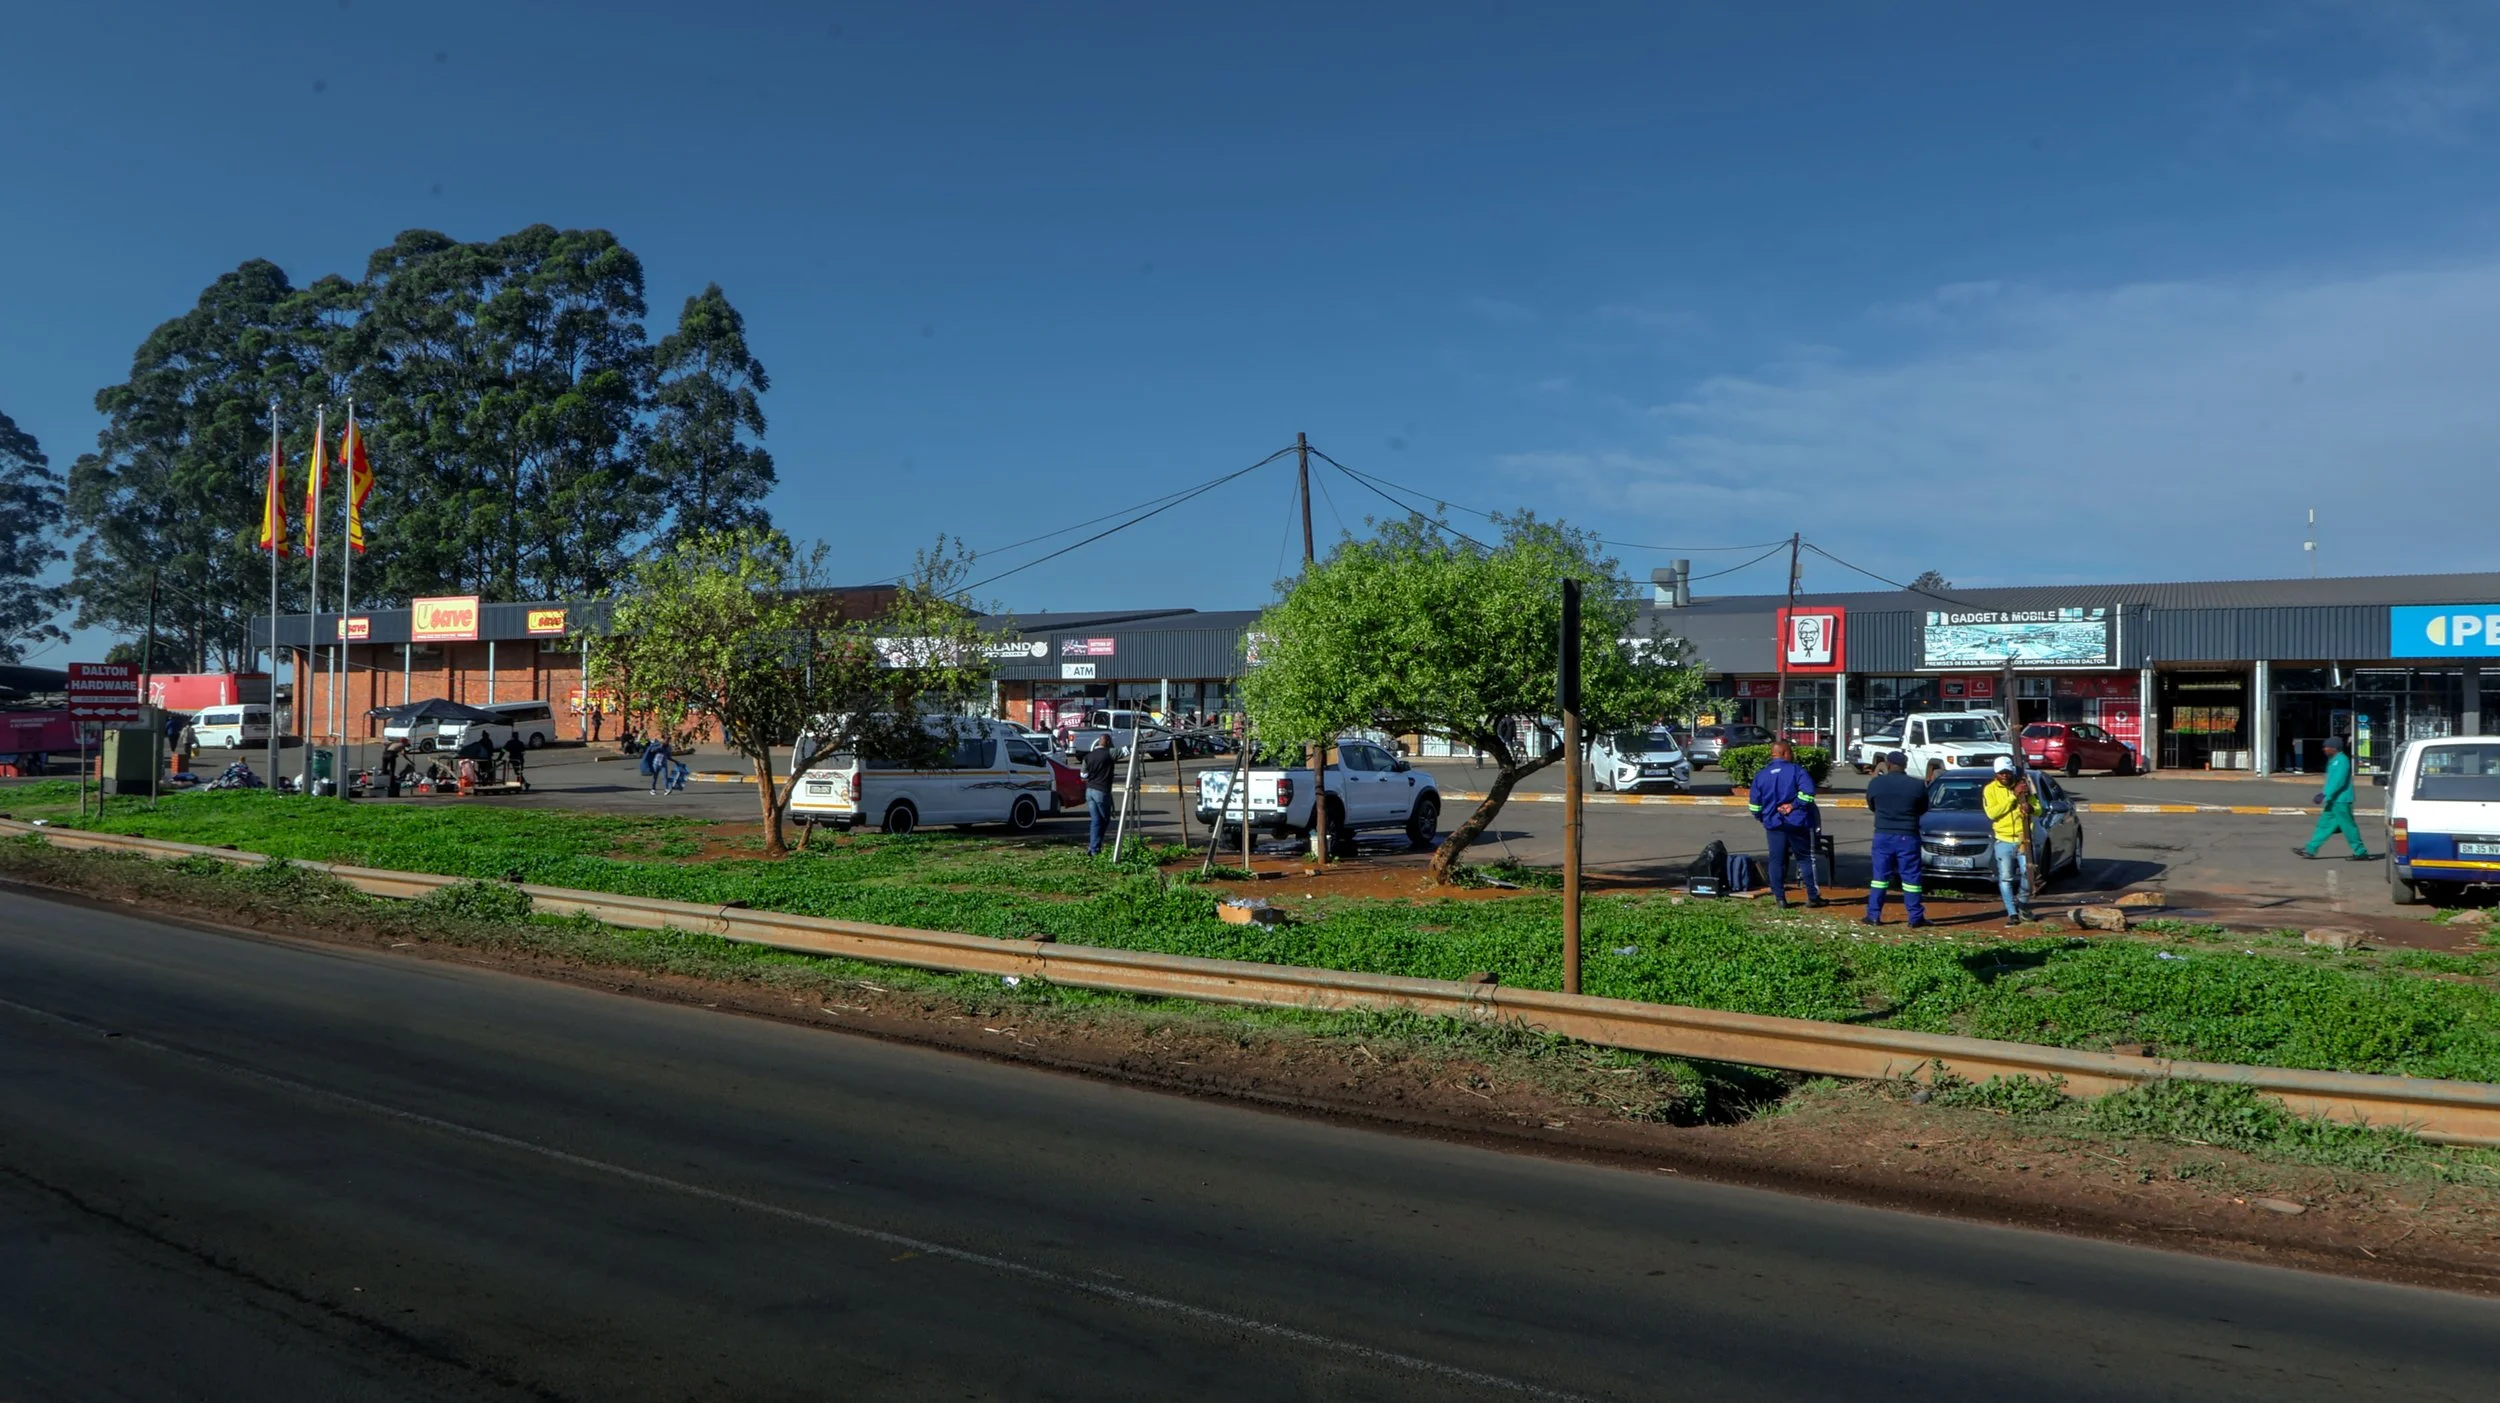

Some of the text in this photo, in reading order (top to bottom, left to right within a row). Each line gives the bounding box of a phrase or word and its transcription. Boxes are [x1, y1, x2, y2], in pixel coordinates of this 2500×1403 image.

[1951, 611, 2056, 623] GADGET & MOBILE
[82, 666, 128, 676] DALTON
[1073, 667, 1094, 676] ATM
[71, 680, 137, 690] HARDWARE
